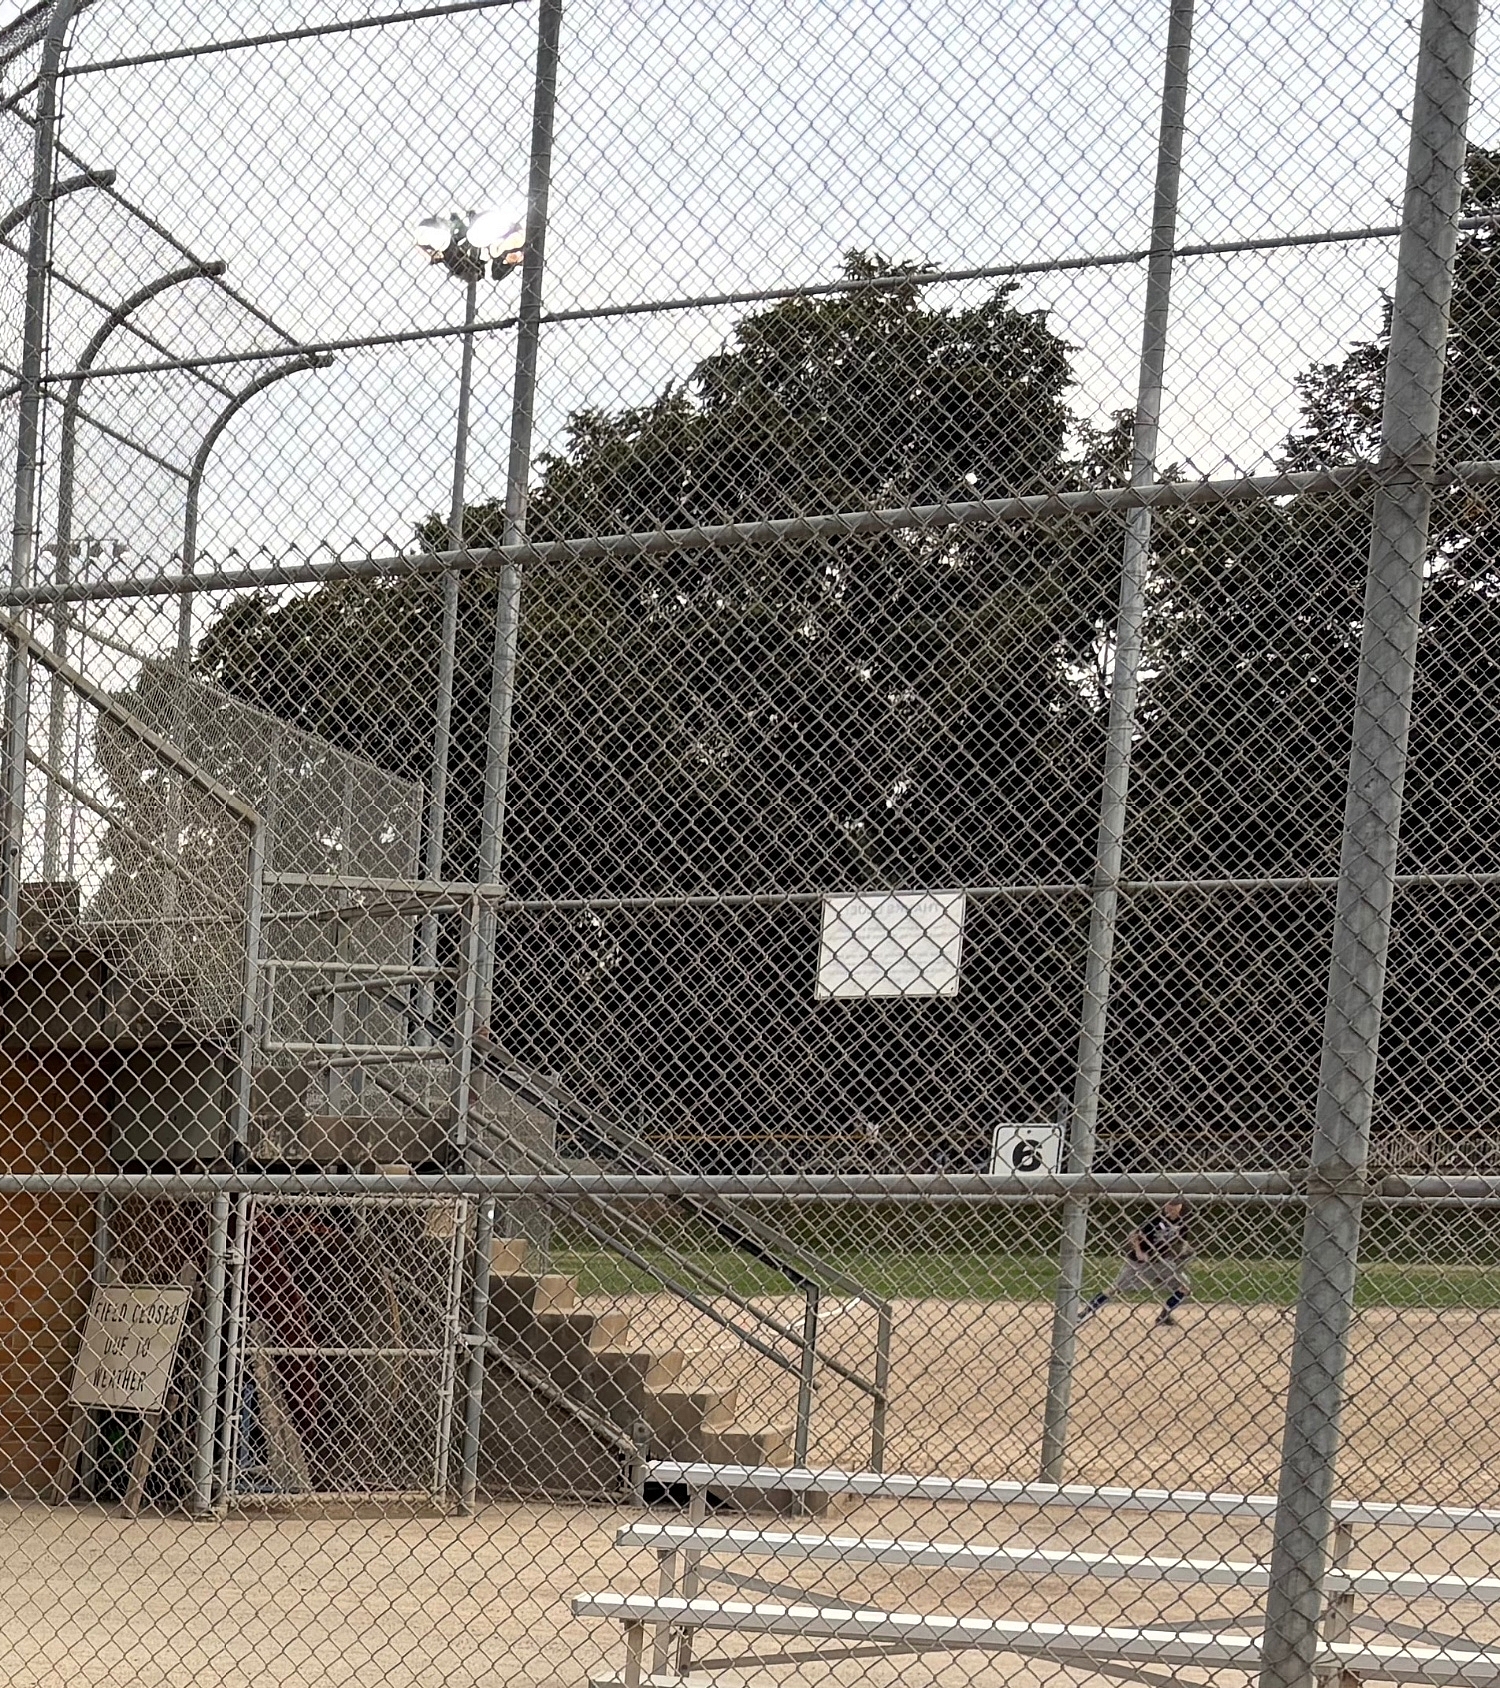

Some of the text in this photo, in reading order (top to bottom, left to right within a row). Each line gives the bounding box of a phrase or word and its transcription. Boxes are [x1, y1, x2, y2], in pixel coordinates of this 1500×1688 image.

[1012, 1139, 1043, 1173] 6
[95, 1303, 180, 1326] FIELD CLOSED
[104, 1336, 151, 1358] DUE TO
[93, 1366, 147, 1392] WEATHER
